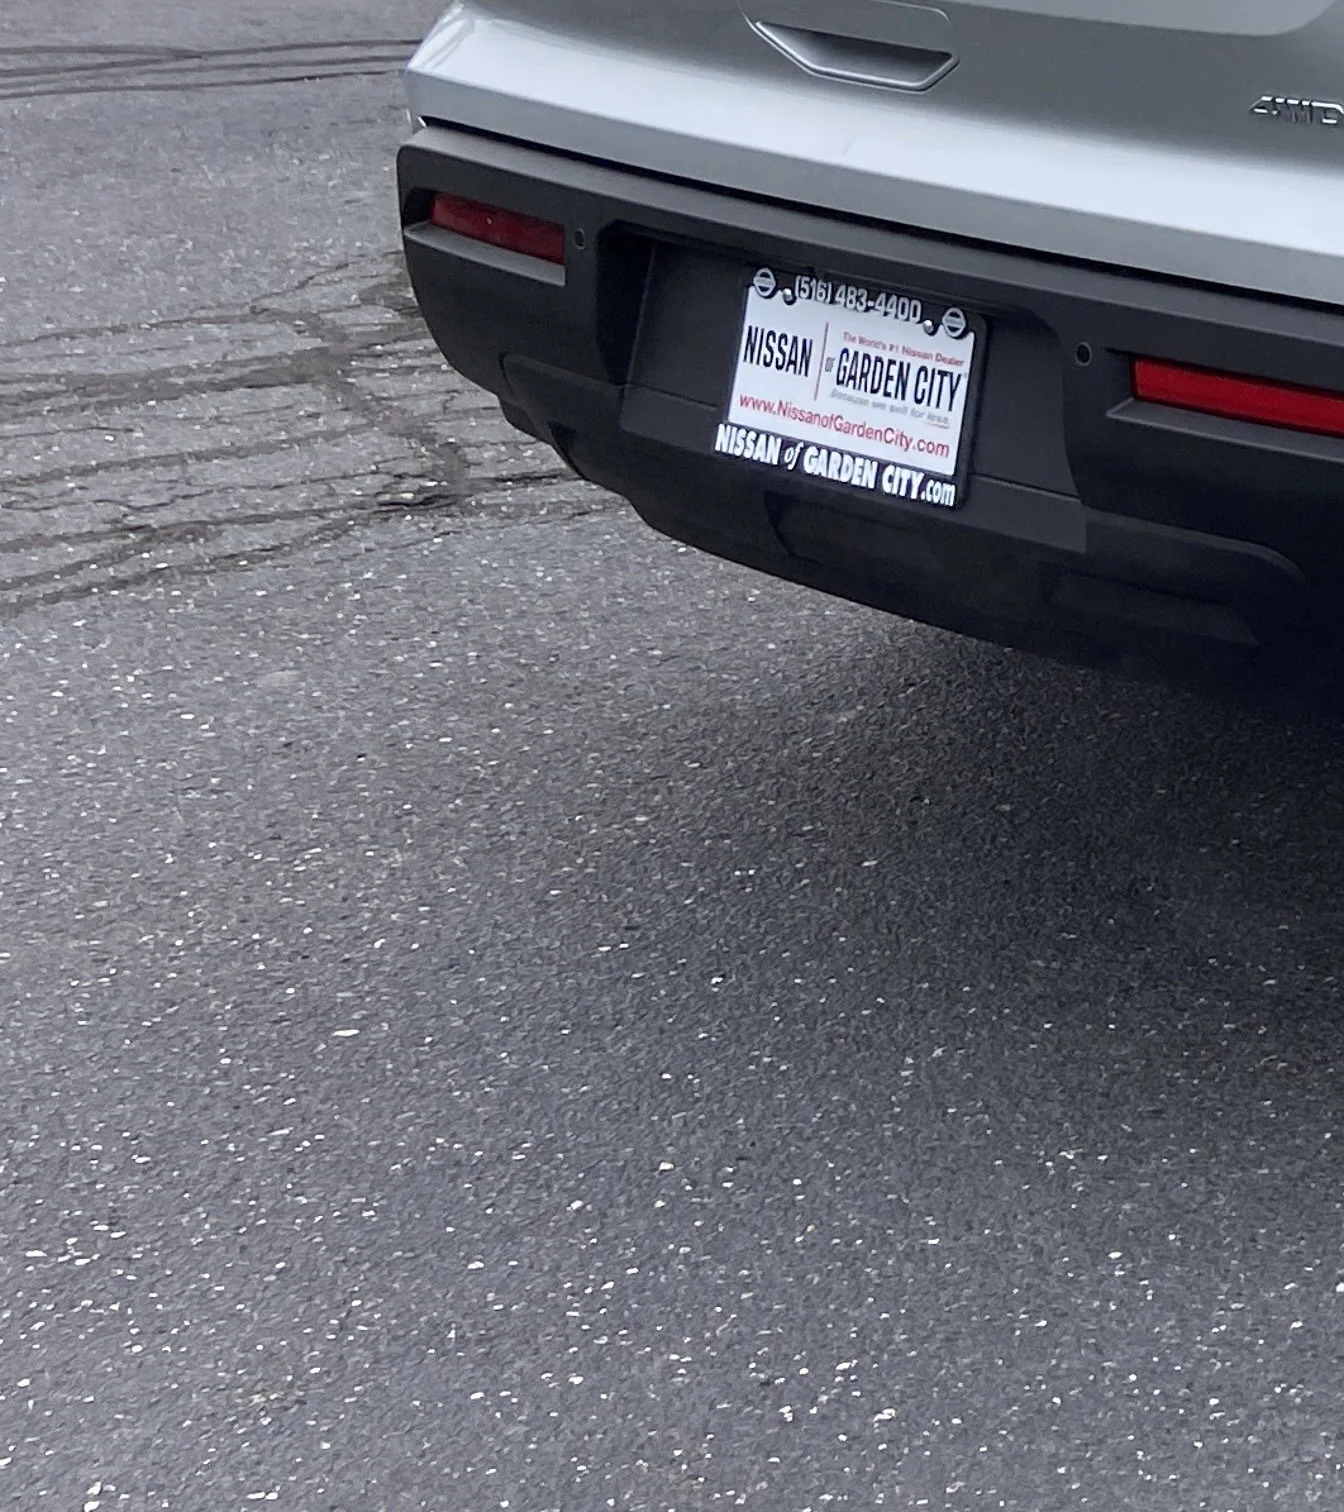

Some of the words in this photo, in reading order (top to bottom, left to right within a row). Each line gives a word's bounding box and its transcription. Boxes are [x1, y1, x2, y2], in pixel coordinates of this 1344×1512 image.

[795, 275, 833, 304] (516)
[835, 285, 922, 323] 483-4400
[743, 325, 813, 377] NISSAN
[836, 348, 911, 401] GARDEN
[914, 365, 962, 412] CITY
[739, 393, 950, 458] www.NissanofGardenCity.com
[715, 424, 782, 465] NISSAN
[784, 441, 804, 470] of
[803, 446, 878, 489] GARDEN
[882, 464, 956, 507] CITY.com
